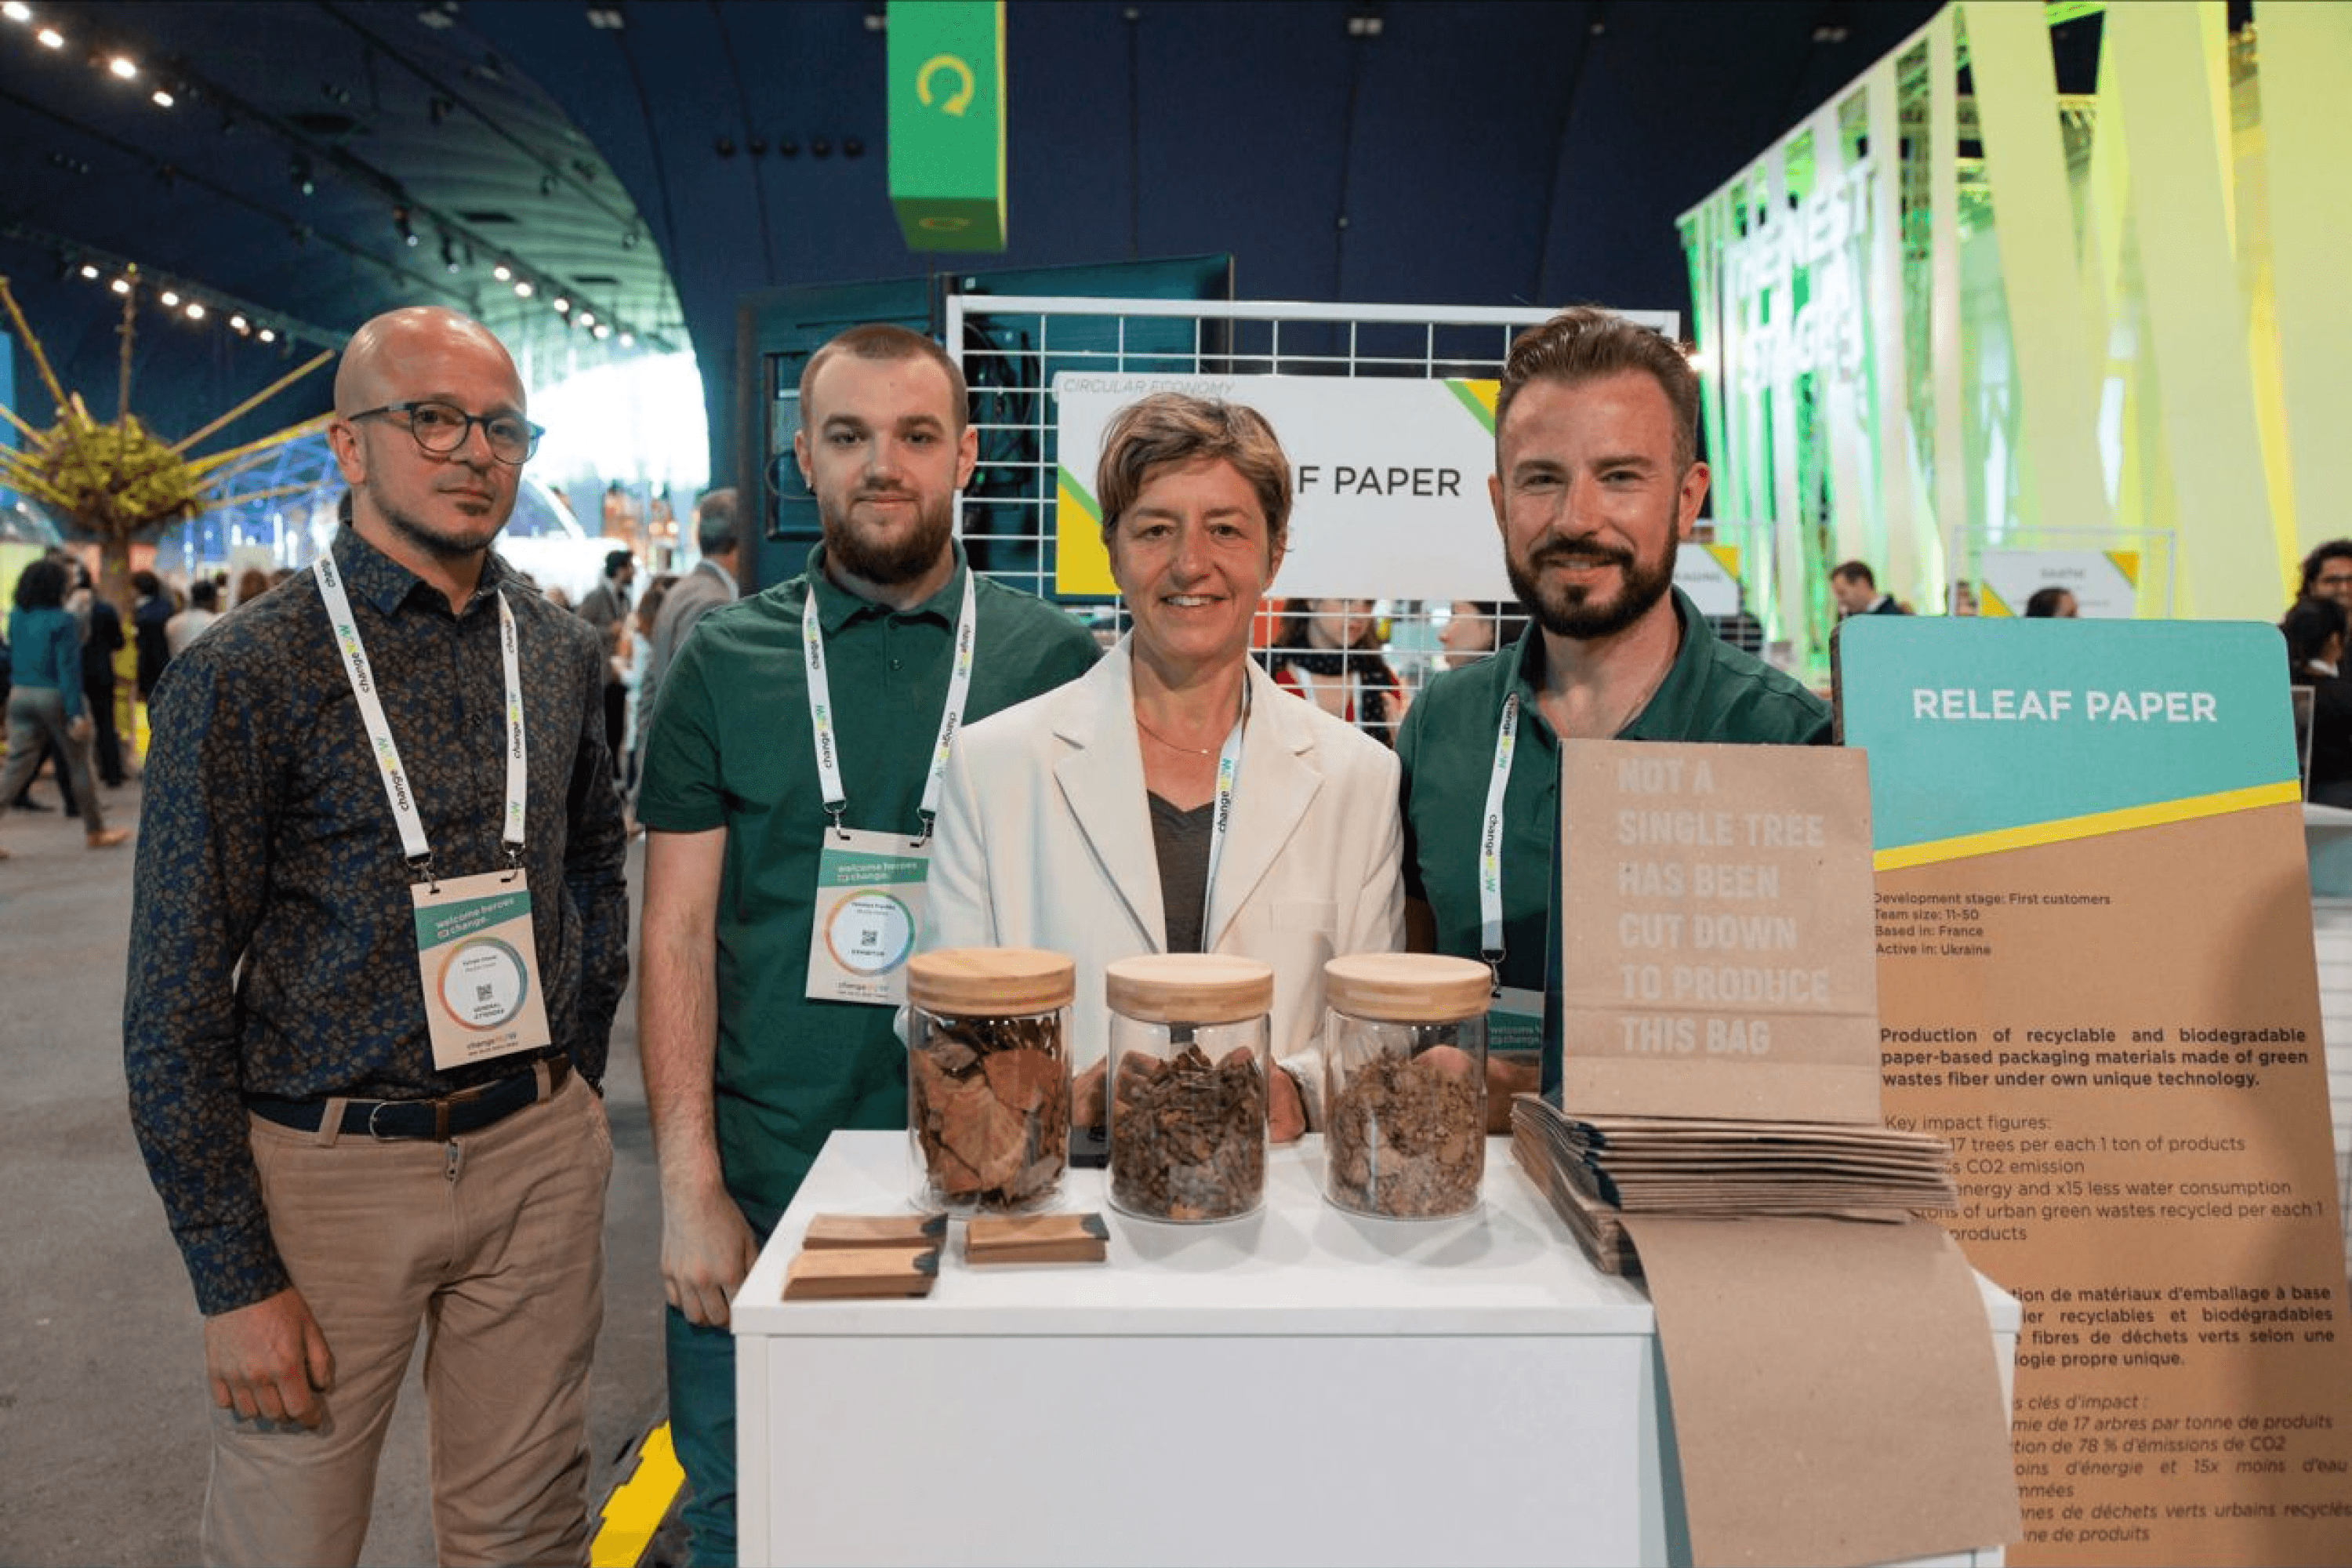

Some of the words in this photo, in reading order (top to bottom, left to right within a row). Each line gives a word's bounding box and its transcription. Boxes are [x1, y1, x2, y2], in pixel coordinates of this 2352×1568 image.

[1063, 378, 1145, 394] CIRCULAR
[1334, 466, 1461, 496] PAPER
[1912, 689, 2071, 720] RELEAF
[2086, 691, 2217, 722] PAPER
[1618, 757, 1683, 794] NOT
[1693, 757, 1714, 794] A
[1617, 810, 1733, 847] SINGLE
[1745, 812, 1825, 847] TREE
[1618, 861, 1685, 898] HAS
[1693, 861, 1779, 898] BEEN
[1965, 894, 2004, 906] stage:
[2009, 893, 2038, 905] First
[2042, 894, 2110, 905] customers
[1912, 909, 1943, 921] size:
[1945, 909, 1980, 920] 11-50
[1619, 913, 1684, 949] CUT
[1694, 913, 1797, 949] DOWN
[1875, 924, 1915, 937] Based
[1919, 924, 1935, 937] in:
[1939, 926, 1984, 937] France
[1876, 942, 1916, 954] Active
[1922, 943, 1936, 955] in:
[1941, 944, 1991, 956] Ukraine
[1620, 965, 1662, 1001] TO
[1672, 965, 1829, 1001] PRODUCE
[1621, 1018, 1695, 1054] THIS
[1707, 1018, 1769, 1054] BAG
[1880, 1028, 1976, 1043] Production
[1993, 1028, 2011, 1043] of
[2027, 1028, 2115, 1045] recyclable
[2132, 1028, 2164, 1043] and
[2179, 1028, 2307, 1045] biodegradable
[1882, 1050, 1993, 1067] paper-based
[1998, 1050, 2089, 1066] packaging
[2096, 1050, 2176, 1063] materials
[2182, 1050, 2228, 1063] made
[2235, 1050, 2253, 1063] of
[2259, 1052, 2308, 1066] green
[1882, 1073, 1942, 1087] wastes
[1947, 1072, 1989, 1086] fiber
[1994, 1072, 2045, 1085] under
[2051, 1074, 2088, 1085] own
[2093, 1072, 2151, 1088] unique
[2157, 1072, 2259, 1088] technology.
[1885, 1114, 1916, 1132] Key
[1923, 1114, 1982, 1132] impact
[1987, 1114, 2051, 1132] figures:
[1973, 1139, 2015, 1152] trees
[2020, 1140, 2049, 1154] per
[2055, 1138, 2095, 1152] each
[2100, 1138, 2106, 1151] 1
[2113, 1138, 2140, 1151] ton
[2146, 1135, 2162, 1151] of
[2168, 1136, 2245, 1152] products
[1967, 1158, 2004, 1174] CO2
[2009, 1160, 2084, 1174] emission
[2018, 1181, 2049, 1196] and
[2056, 1181, 2082, 1196] x15
[2088, 1181, 2120, 1196] less
[2125, 1181, 2173, 1196] water
[2180, 1181, 2290, 1196] consumption
[1964, 1203, 1980, 1218] of
[1987, 1203, 2036, 1218] urban
[2042, 1205, 2091, 1221] green
[2096, 1203, 2155, 1218] wastes
[2161, 1202, 2232, 1220] recycled
[2239, 1205, 2265, 1218] per
[2272, 1203, 2312, 1218] each
[2051, 1287, 2071, 1302] de
[2078, 1287, 2162, 1301] matériaux
[2168, 1287, 2270, 1303] d'emballage
[2276, 1286, 2285, 1300] à
[2292, 1285, 2330, 1300] base
[2060, 1308, 2154, 1325] recyclables
[2170, 1309, 2186, 1322] et
[2202, 1307, 2332, 1323] biodégradables
[2031, 1330, 2078, 1344] fibres
[2089, 1330, 2111, 1344] de
[2122, 1329, 2188, 1344] déchets
[2198, 1330, 2239, 1343] verts
[2250, 1327, 2294, 1343] selon
[2304, 1331, 2334, 1342] une
[2062, 1355, 2117, 1367] propre
[2124, 1351, 2184, 1367] unique.
[2029, 1395, 2060, 1410] clés
[2066, 1395, 2139, 1411] d'impact
[2048, 1417, 2067, 1431] de
[2074, 1416, 2089, 1430] 17
[2095, 1417, 2147, 1431] arbres
[2151, 1418, 2180, 1433] par
[2186, 1417, 2232, 1430] tonne
[2238, 1415, 2259, 1429] de
[2263, 1414, 2333, 1431] produits
[2051, 1439, 2073, 1454] de
[2078, 1438, 2099, 1453] 78
[2104, 1438, 2117, 1453] %
[2122, 1438, 2217, 1453] d'émissions
[2223, 1437, 2245, 1451] de
[2250, 1435, 2286, 1451] CO2
[2014, 1464, 2049, 1476] oins
[2066, 1461, 2143, 1478] d'énergie
[2161, 1460, 2177, 1473] et
[2195, 1458, 2218, 1473] 15x
[2235, 1458, 2286, 1473] moins
[2303, 1457, 2348, 1473] d'eau
[2062, 1504, 2082, 1520] de
[2091, 1504, 2157, 1519] déchets
[2166, 1504, 2206, 1519] verts
[2215, 1502, 2276, 1517] urbains
[2053, 1527, 2074, 1542] de
[2078, 1526, 2150, 1544] produits
